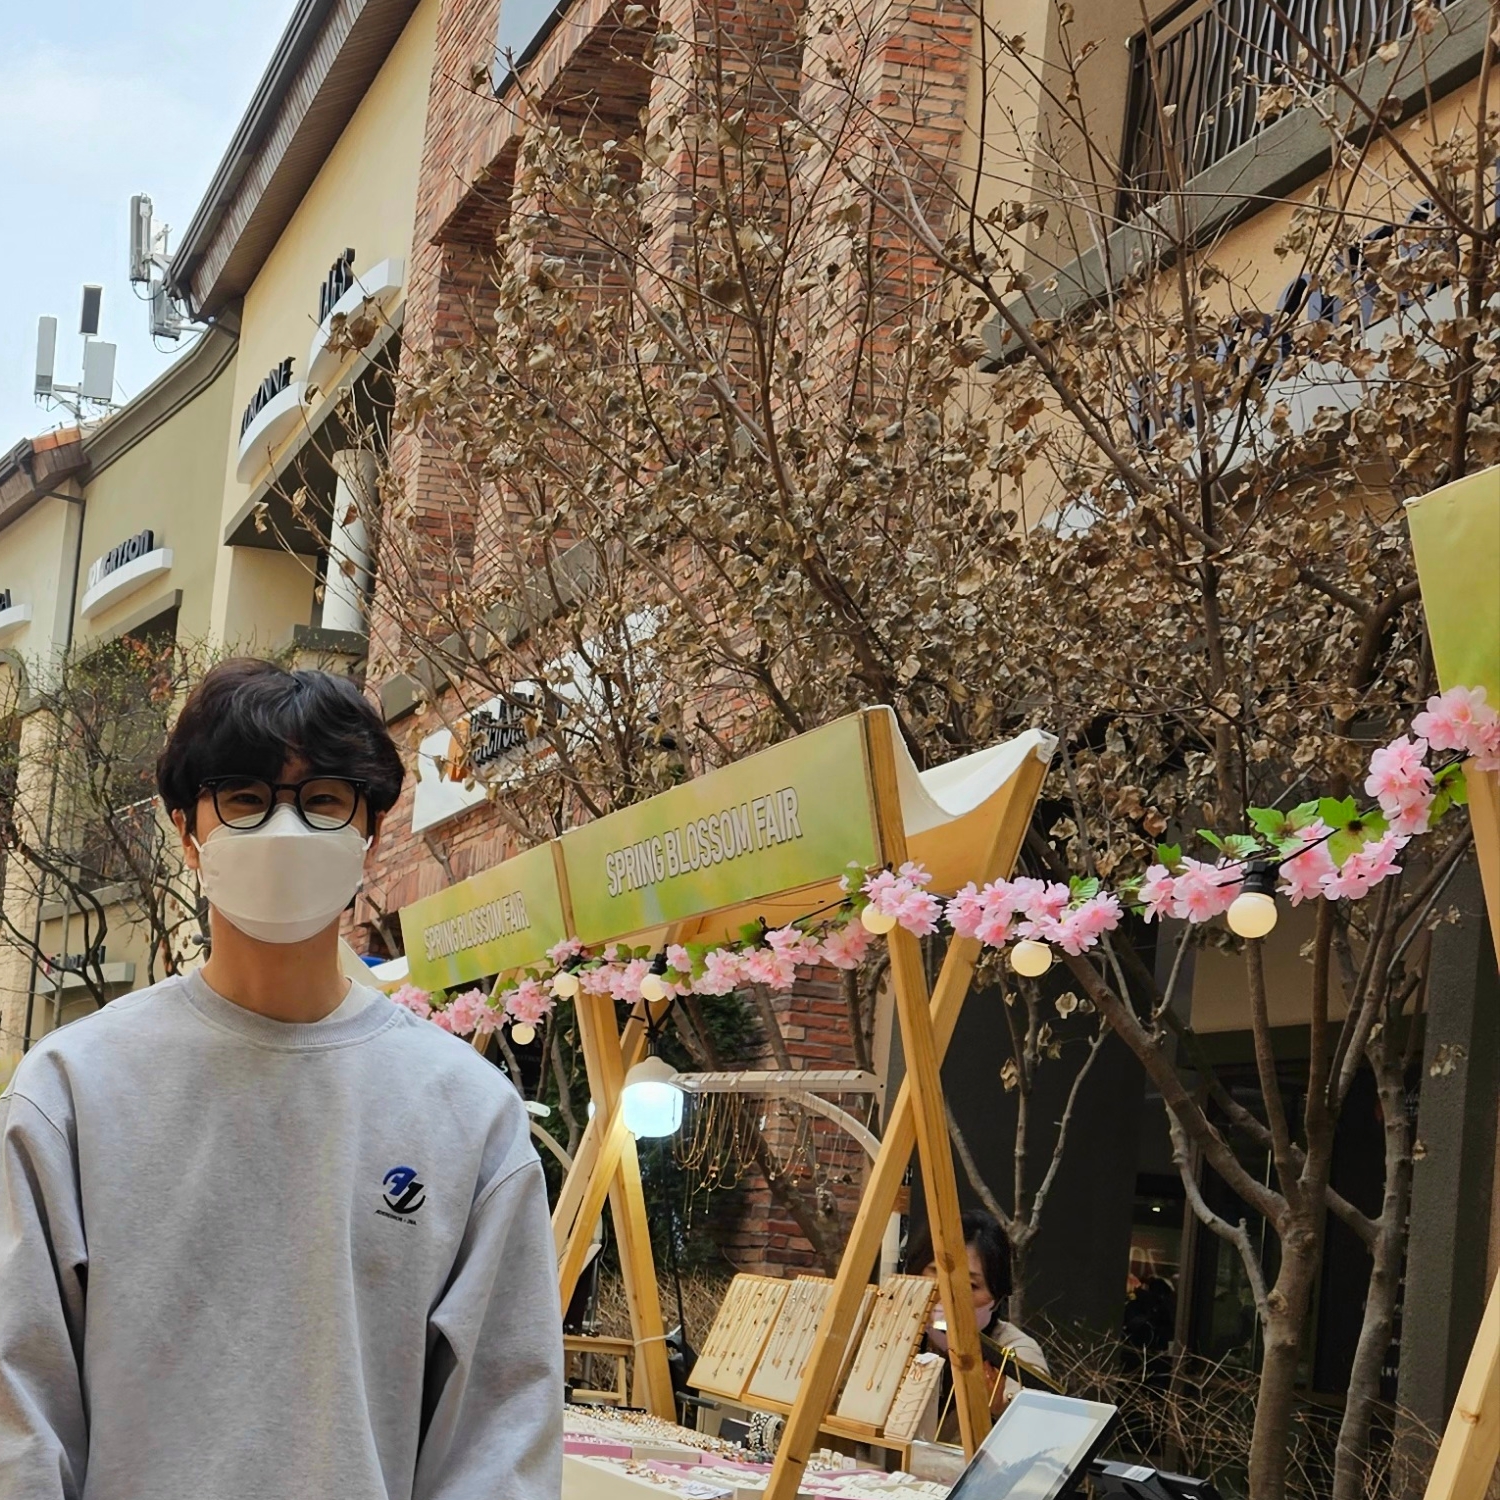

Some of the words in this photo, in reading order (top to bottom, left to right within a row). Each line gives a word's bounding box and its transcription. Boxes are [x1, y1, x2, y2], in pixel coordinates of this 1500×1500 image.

[606, 835, 665, 898] SPRING
[663, 803, 754, 879] BLOSSOM
[752, 786, 804, 850] FAIR
[424, 918, 460, 962] SPRING
[457, 898, 505, 951] BLOSSOM
[502, 889, 531, 935] FAIR
